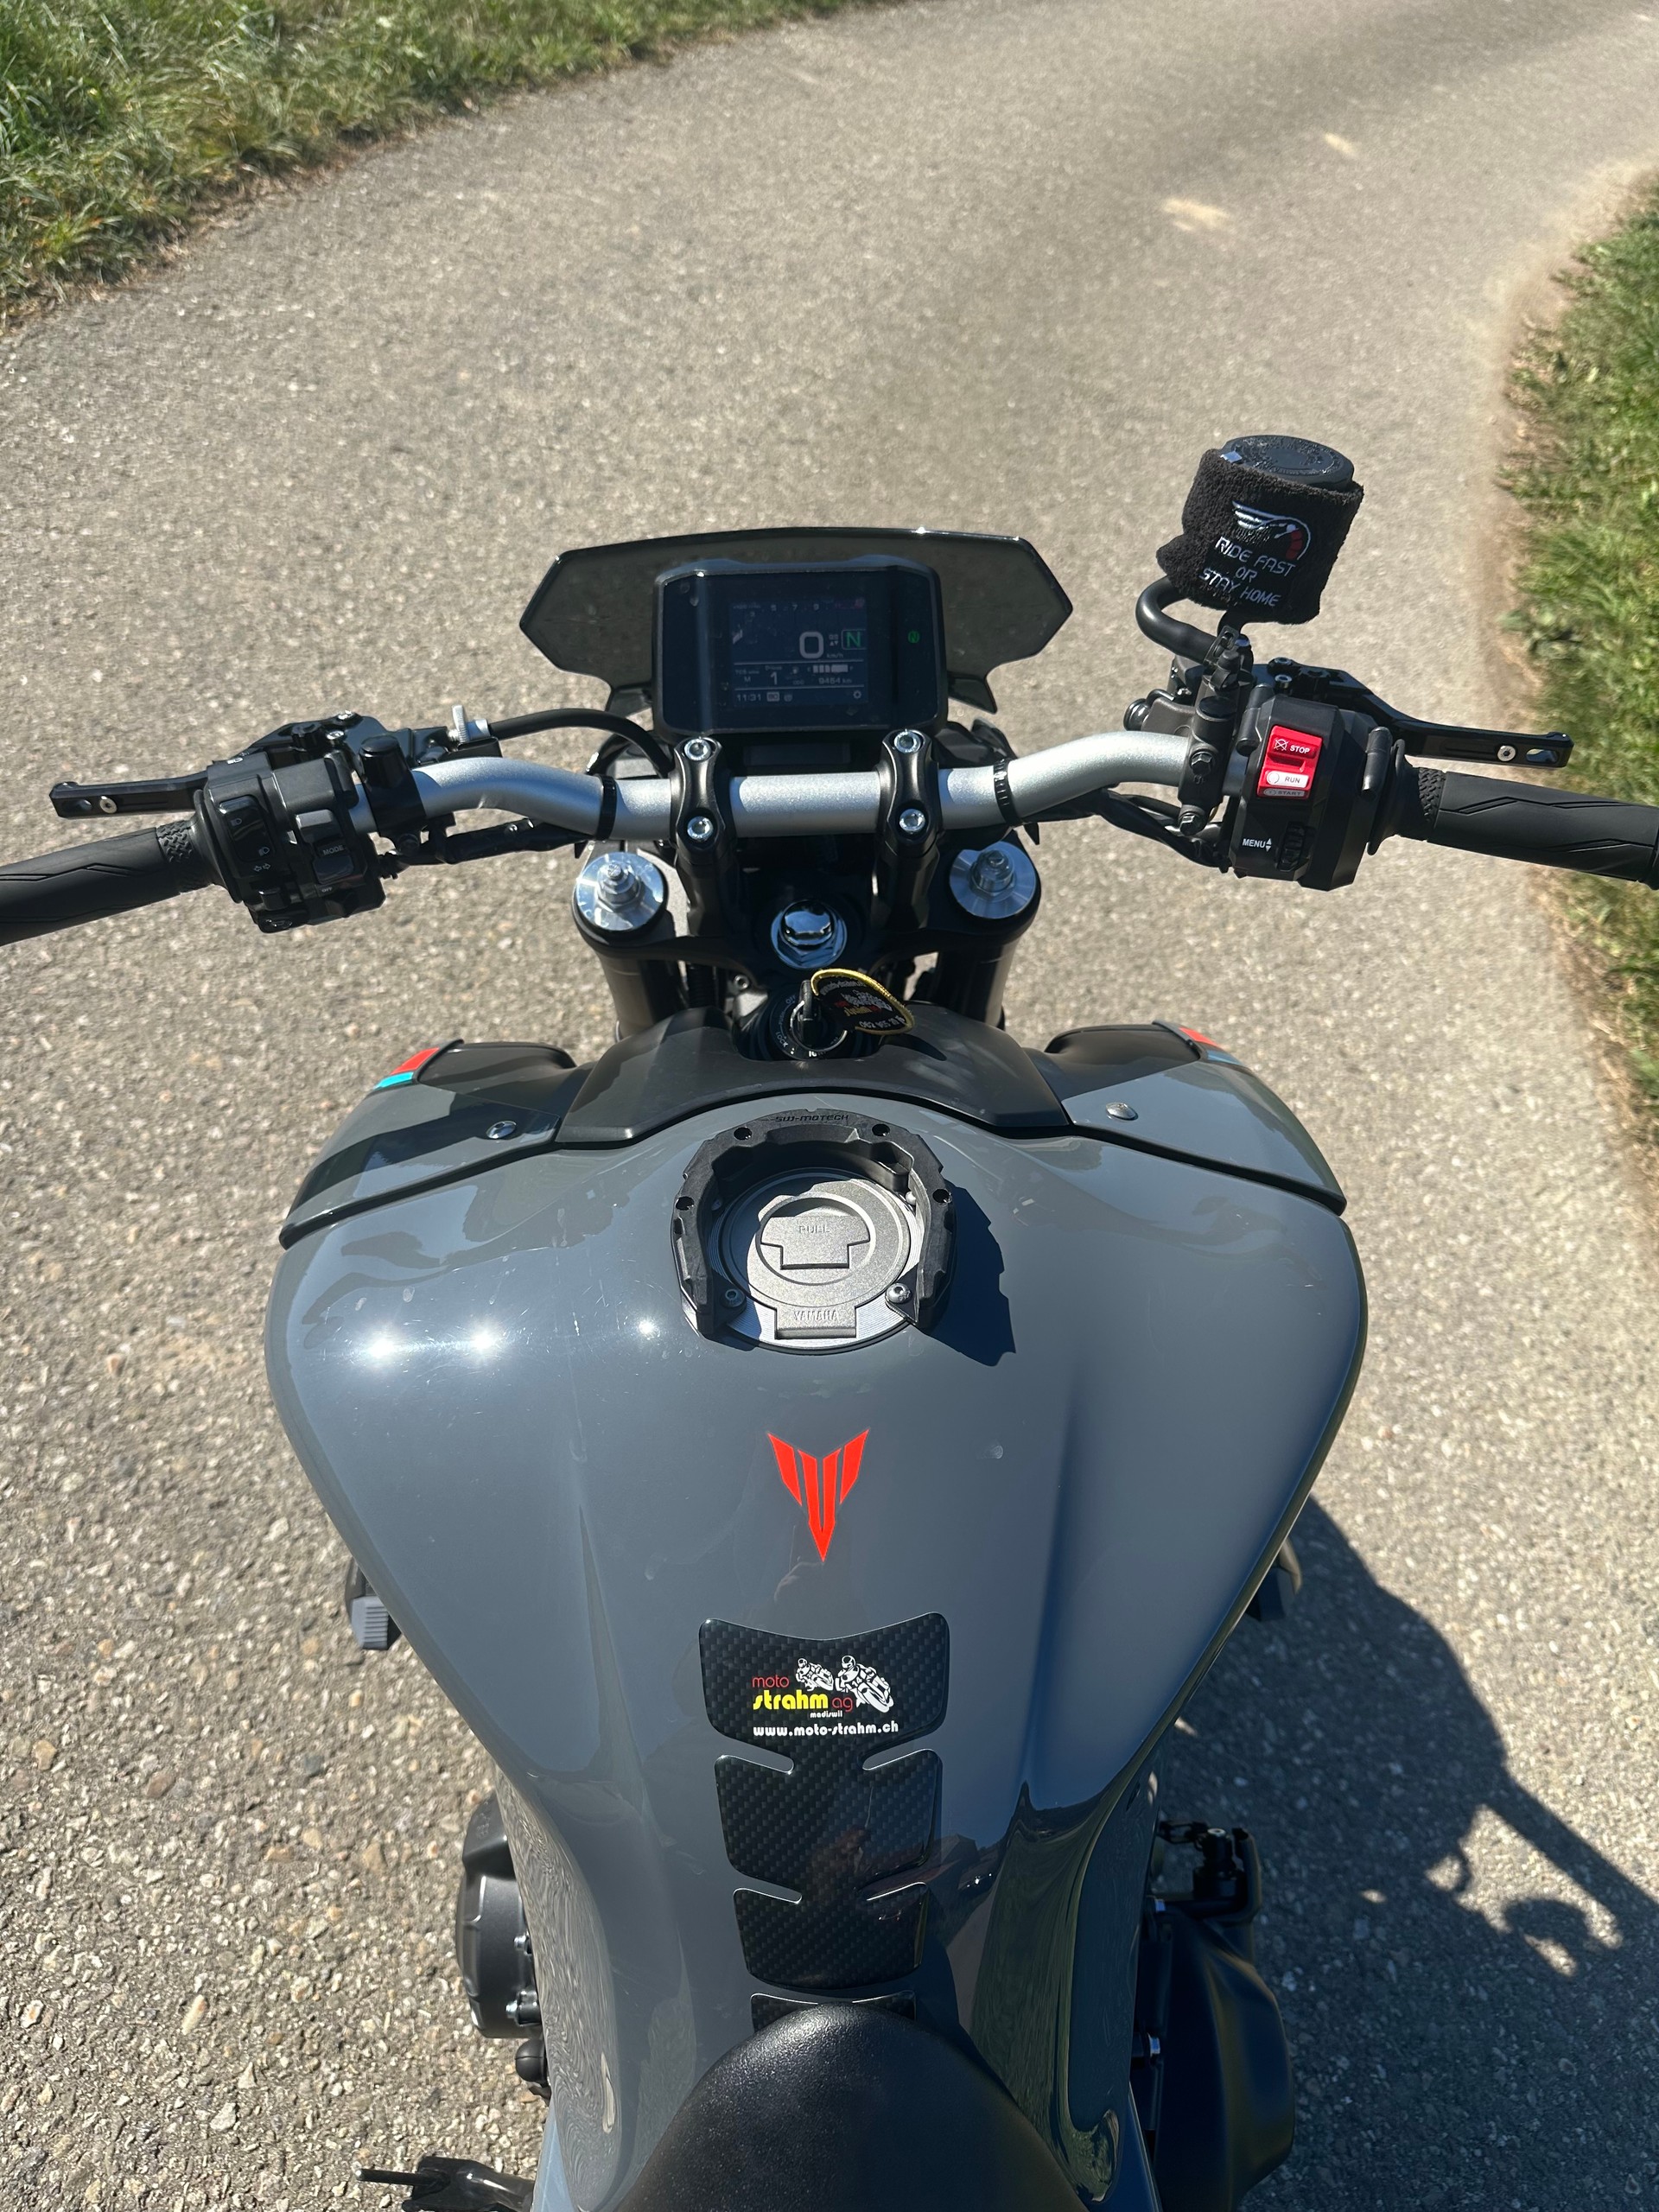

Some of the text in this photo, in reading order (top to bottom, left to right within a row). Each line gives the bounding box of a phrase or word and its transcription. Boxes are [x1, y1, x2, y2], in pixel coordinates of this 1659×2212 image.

[1215, 536, 1296, 577] RIDE FAST
[1236, 566, 1257, 582] OR
[1198, 568, 1281, 607] STAY HOME
[799, 632, 823, 659] 0
[847, 631, 861, 647] N
[770, 671, 777, 685] 1
[1289, 744, 1310, 754] STOP
[322, 844, 344, 855] MODE
[1242, 838, 1266, 849] MENU
[775, 1031, 789, 1048] LOCK
[775, 1114, 849, 1122] SW-MOTECH
[794, 1309, 840, 1321] YAMAHA
[752, 1675, 790, 1688] moto
[753, 1689, 854, 1712] strahm ag
[810, 1710, 842, 1719] madiswil
[753, 1720, 899, 1737] www.moto-strahm.ch
